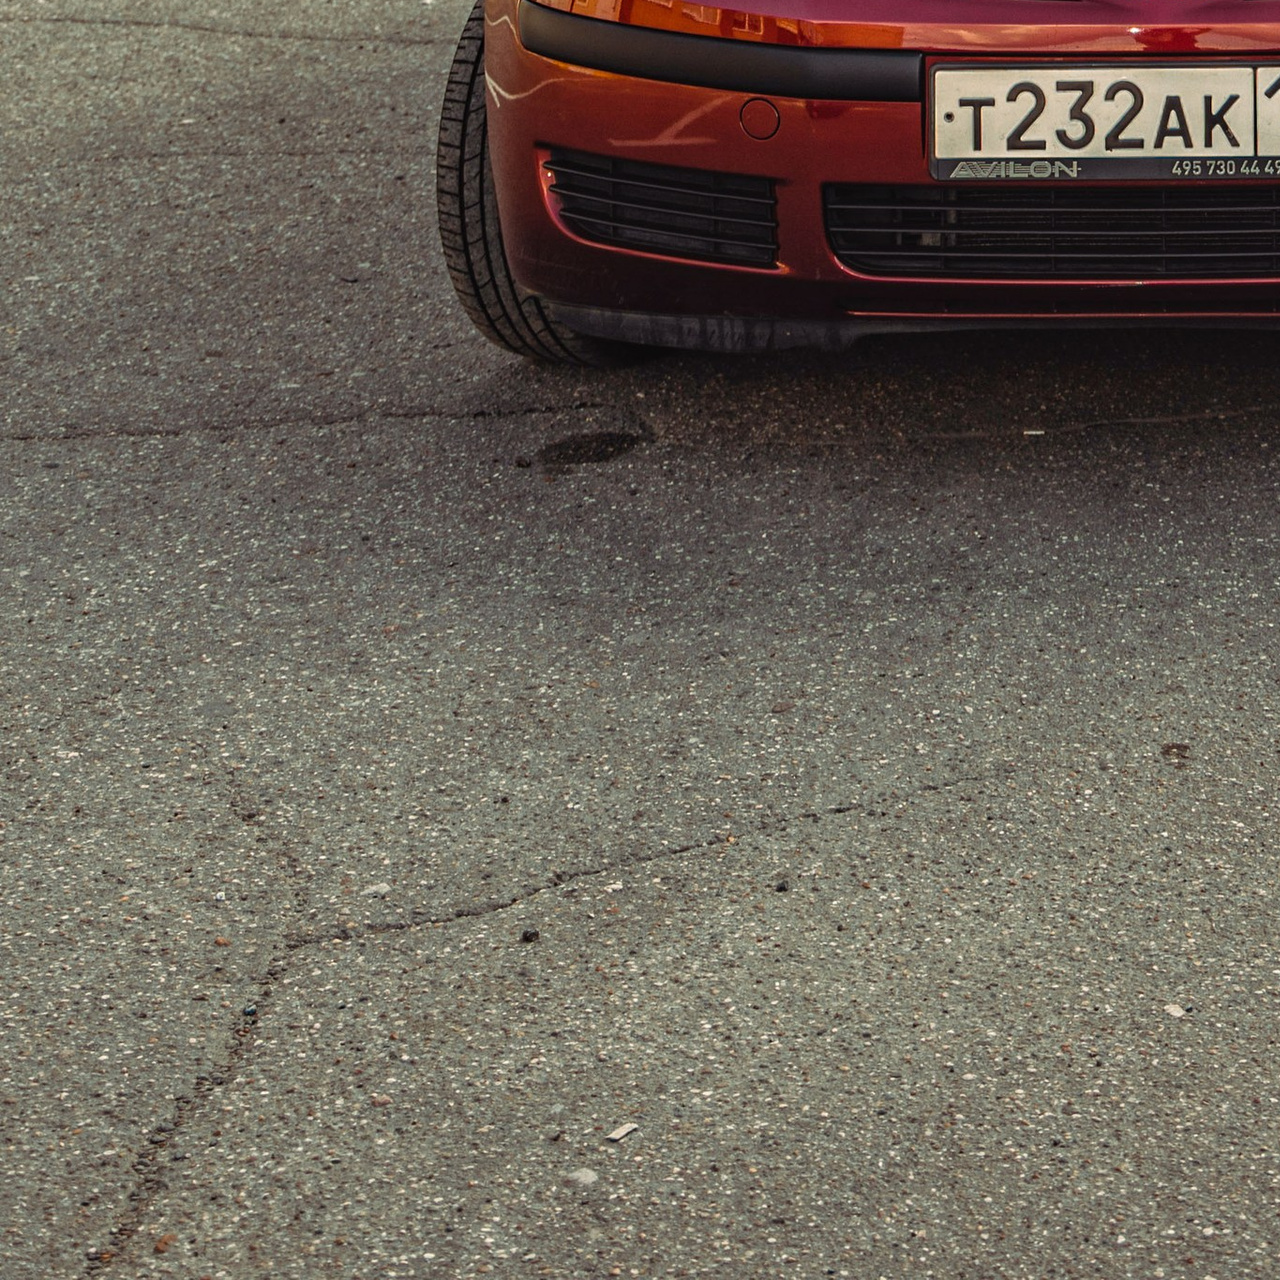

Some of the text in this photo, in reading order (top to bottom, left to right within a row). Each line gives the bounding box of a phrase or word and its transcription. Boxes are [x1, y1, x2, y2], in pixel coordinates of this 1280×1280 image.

[950, 160, 1079, 179] AVILON
[1172, 160, 1201, 176] 495
[1206, 160, 1236, 175] 730
[1240, 160, 1260, 175] 44
